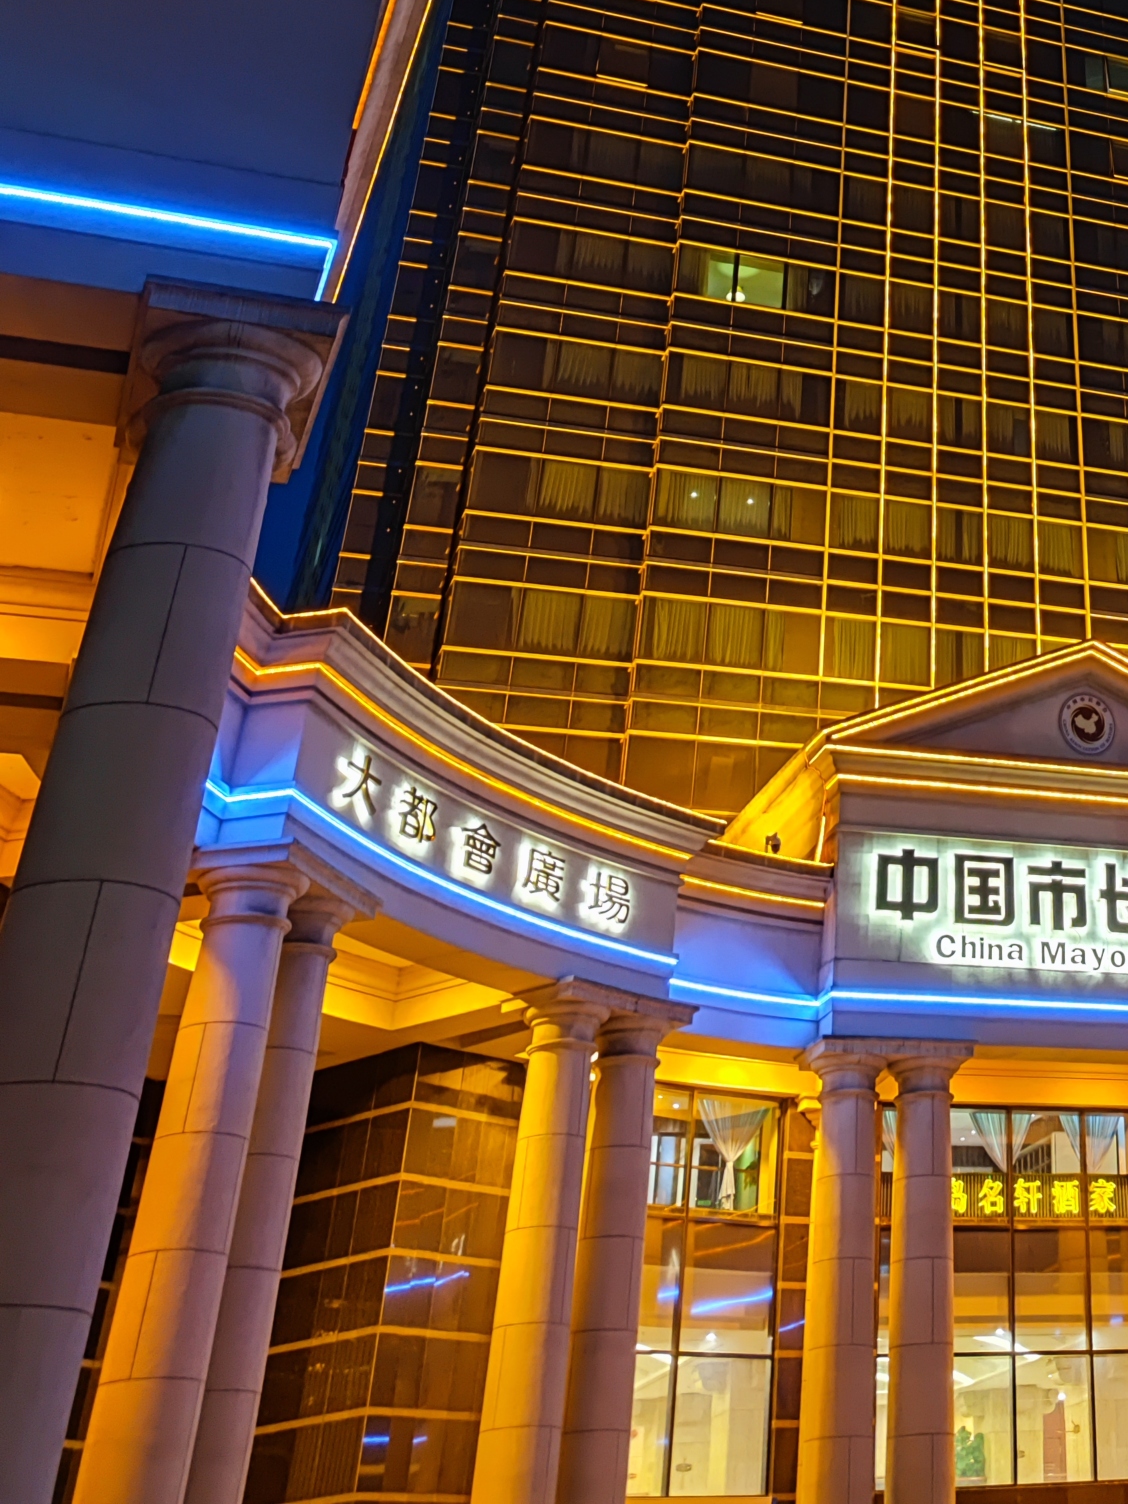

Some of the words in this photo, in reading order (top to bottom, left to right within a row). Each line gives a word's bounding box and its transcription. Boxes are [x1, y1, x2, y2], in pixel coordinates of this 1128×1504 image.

[341, 754, 631, 924] 大都會廣場
[935, 933, 1024, 963] China
